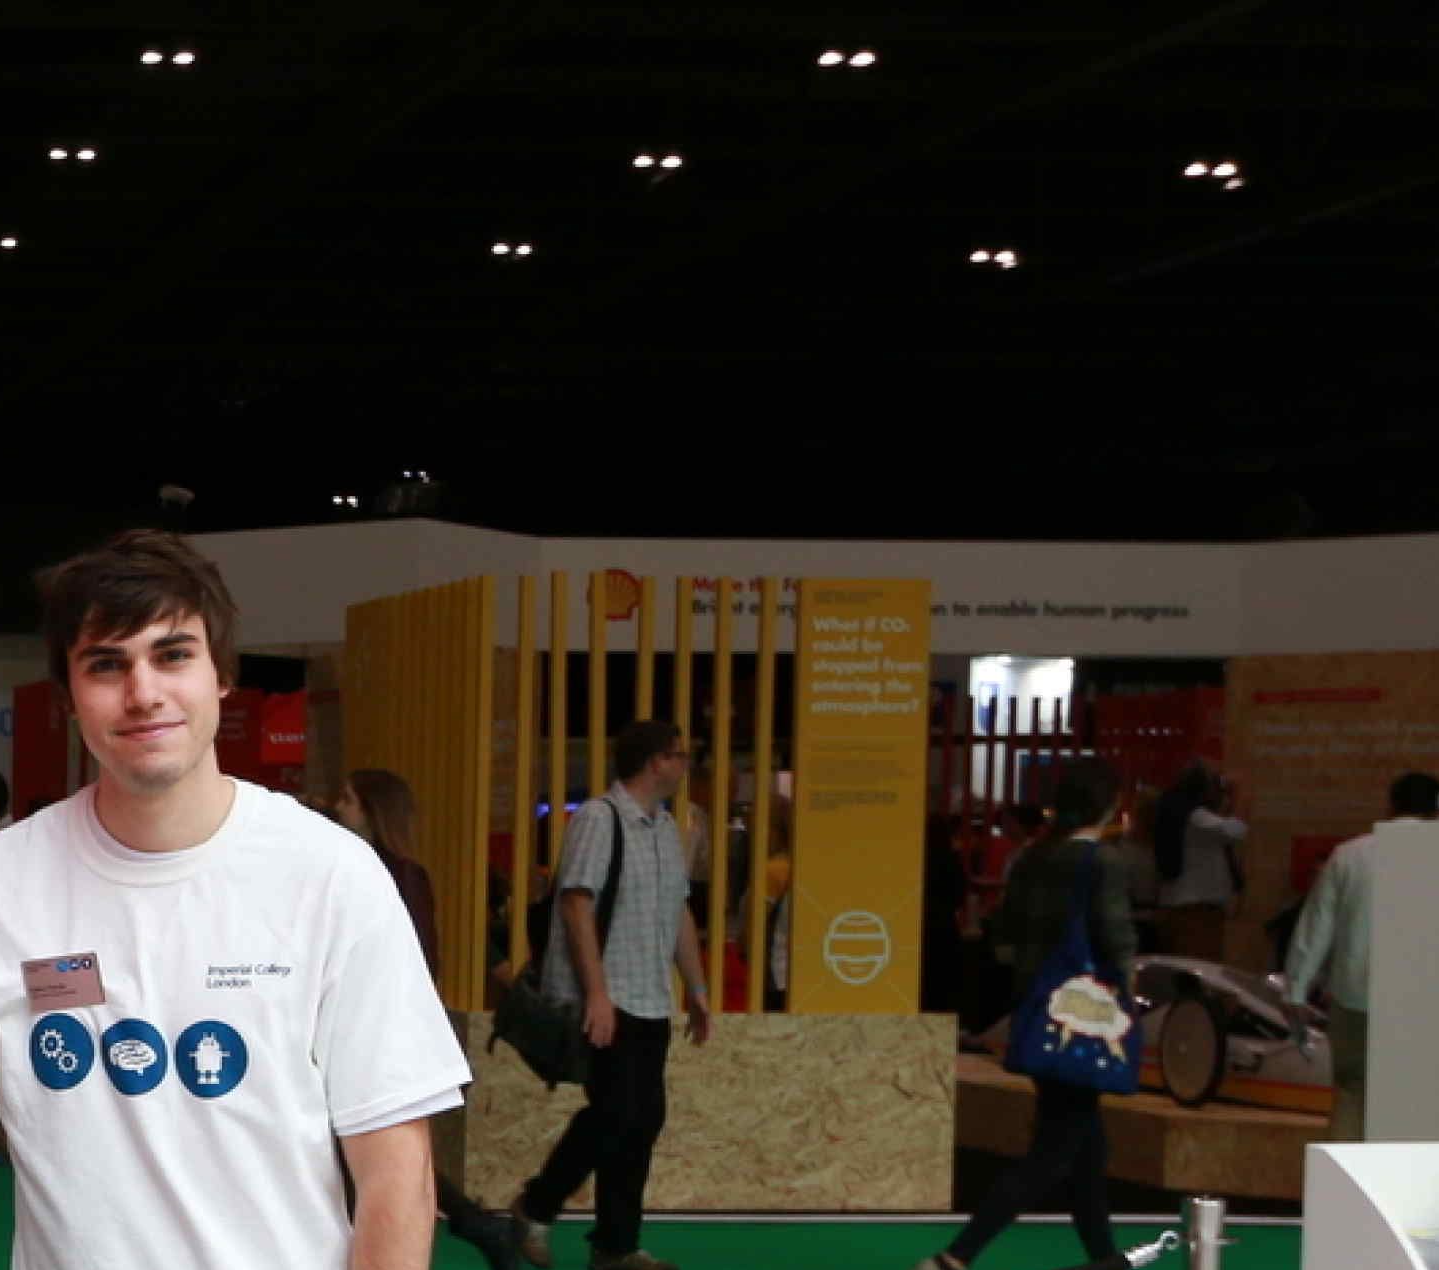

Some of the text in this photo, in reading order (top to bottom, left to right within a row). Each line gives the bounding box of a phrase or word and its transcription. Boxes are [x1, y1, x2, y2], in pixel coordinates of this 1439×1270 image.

[952, 602, 971, 617] to
[976, 600, 1038, 617] enable
[1042, 601, 1106, 617] human
[1111, 604, 1189, 621] progress
[813, 616, 859, 632] What
[864, 615, 876, 632] if
[812, 635, 884, 652] could be
[812, 656, 925, 675] stopped from
[811, 676, 912, 696] entering the
[811, 698, 920, 716] atmosphere?
[208, 963, 253, 978] Imperial
[206, 977, 251, 990] London
